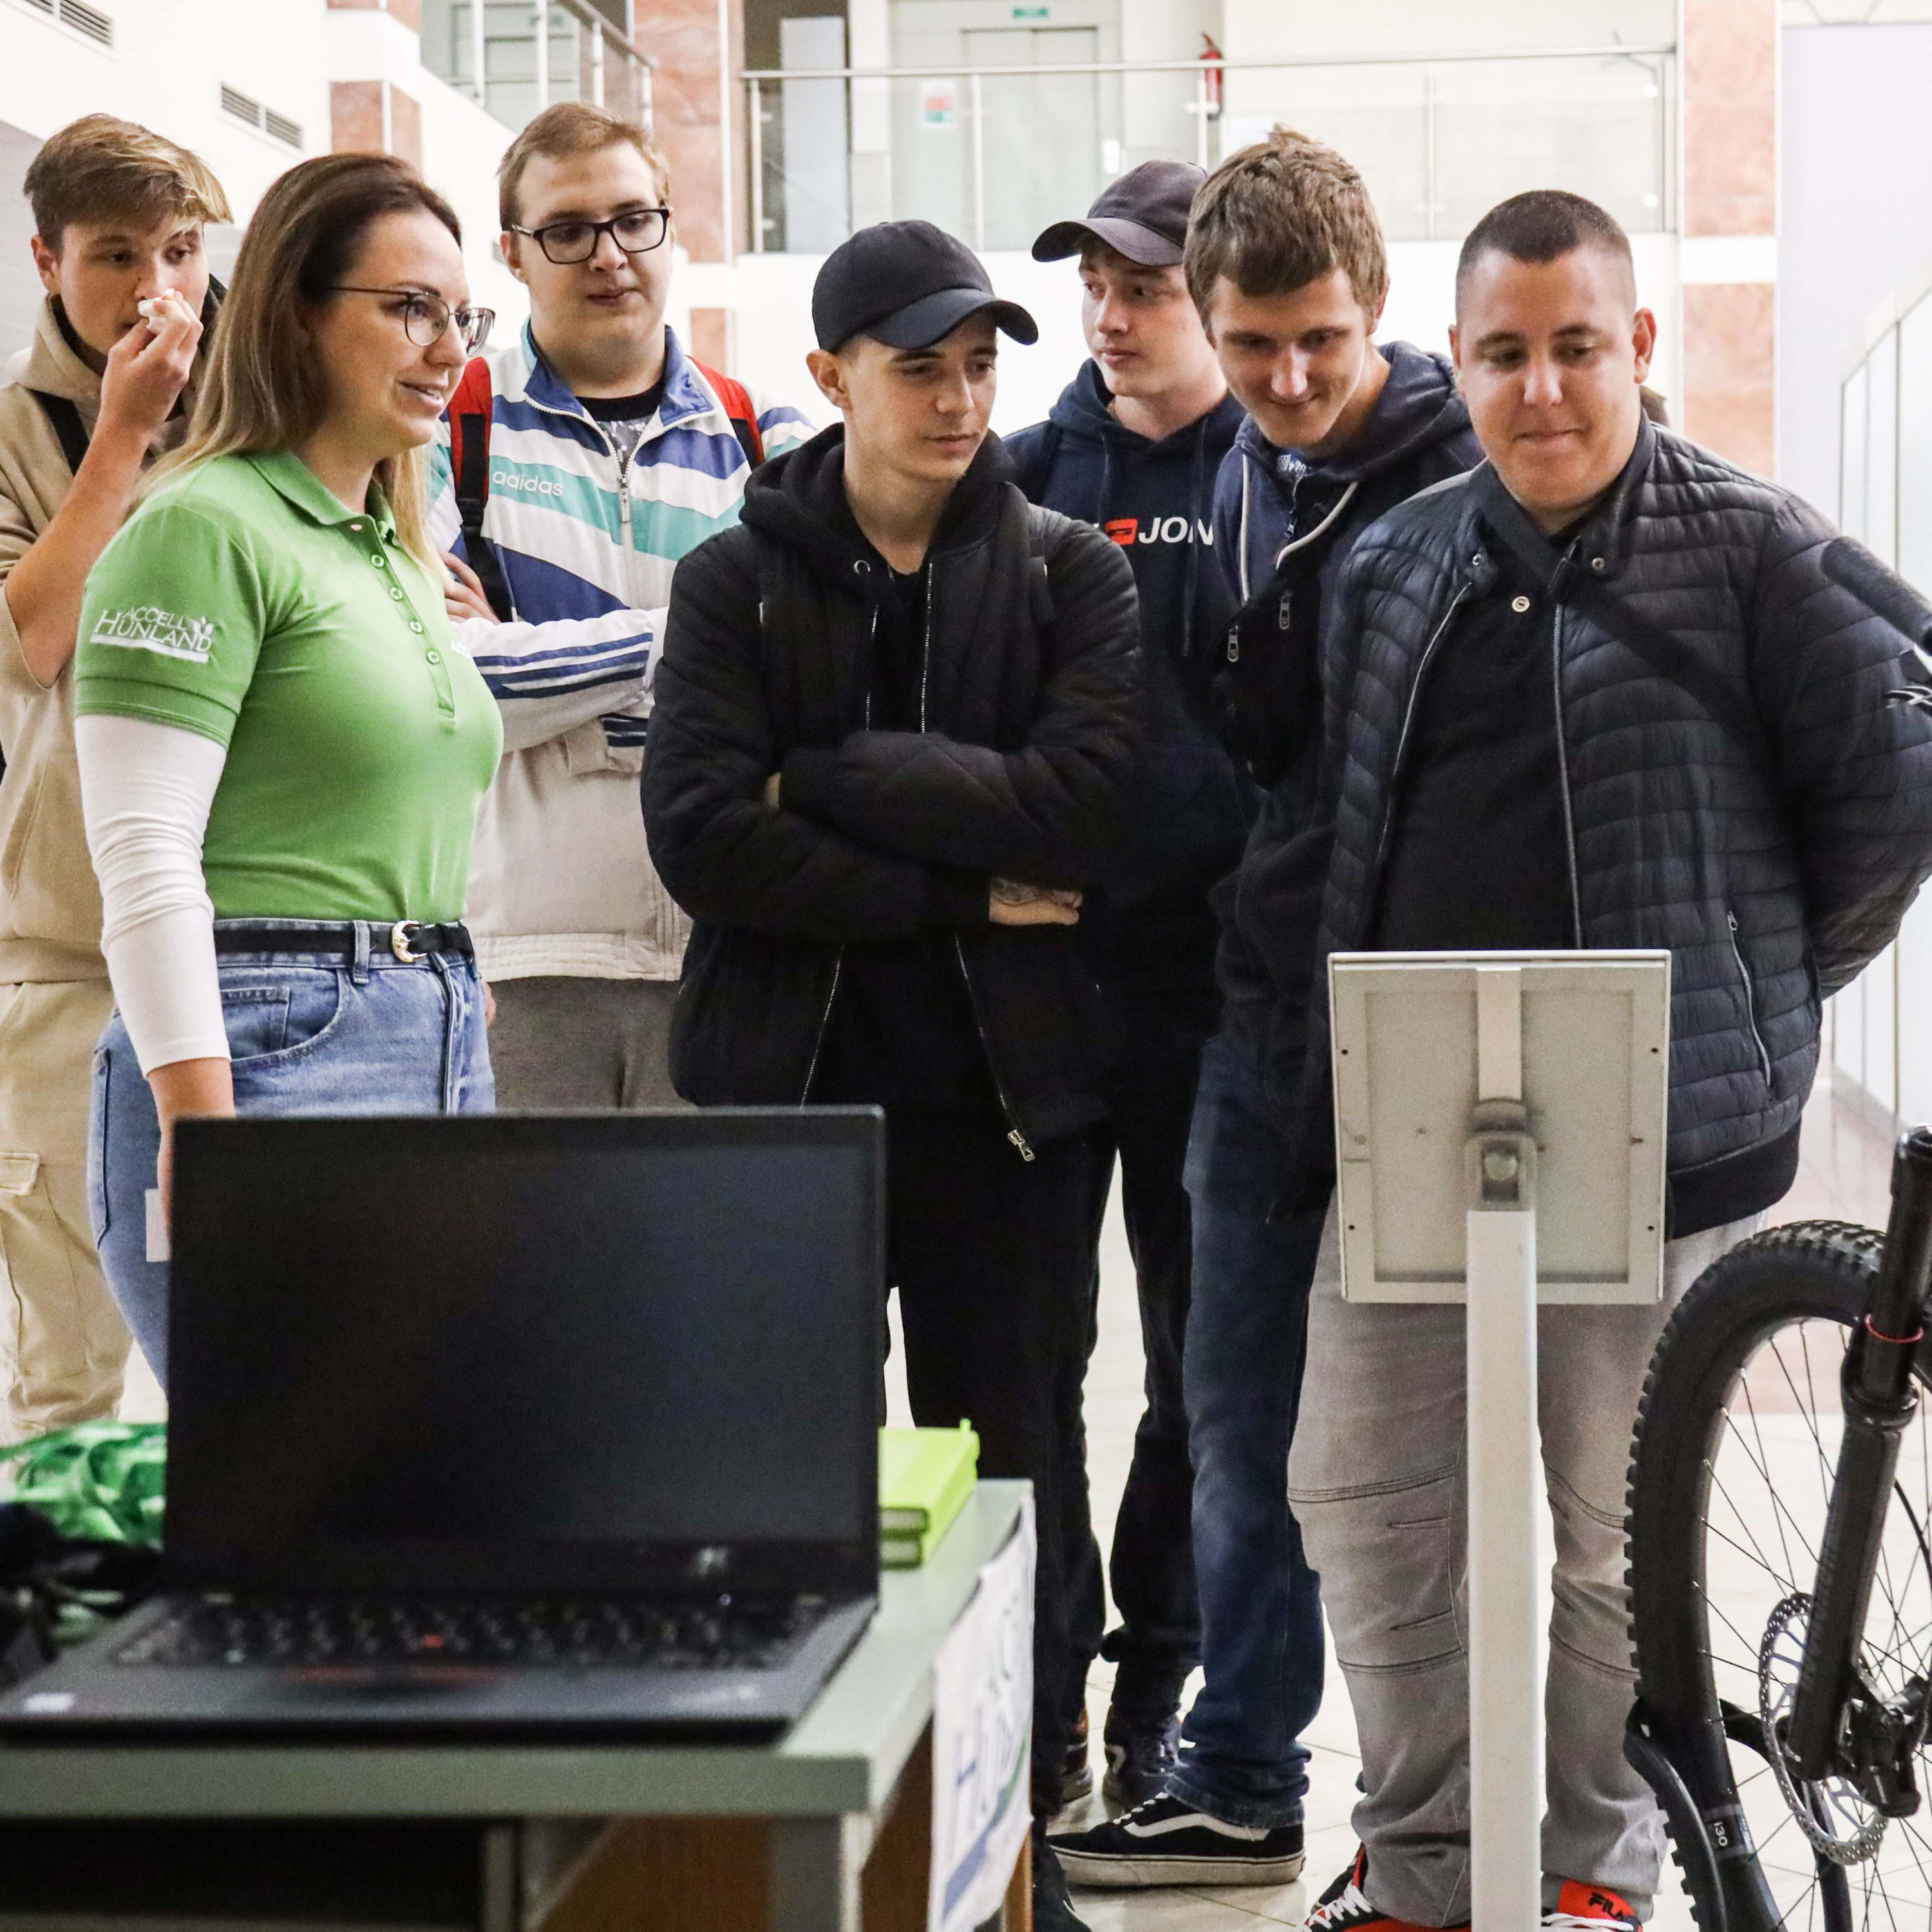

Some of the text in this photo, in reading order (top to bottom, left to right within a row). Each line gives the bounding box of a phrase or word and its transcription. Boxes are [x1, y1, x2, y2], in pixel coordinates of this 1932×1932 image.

[492, 471, 564, 497] adidas
[94, 609, 212, 652] HUNLAND
[122, 607, 187, 630] ACCELL
[1588, 1891, 1624, 1922] FILA
